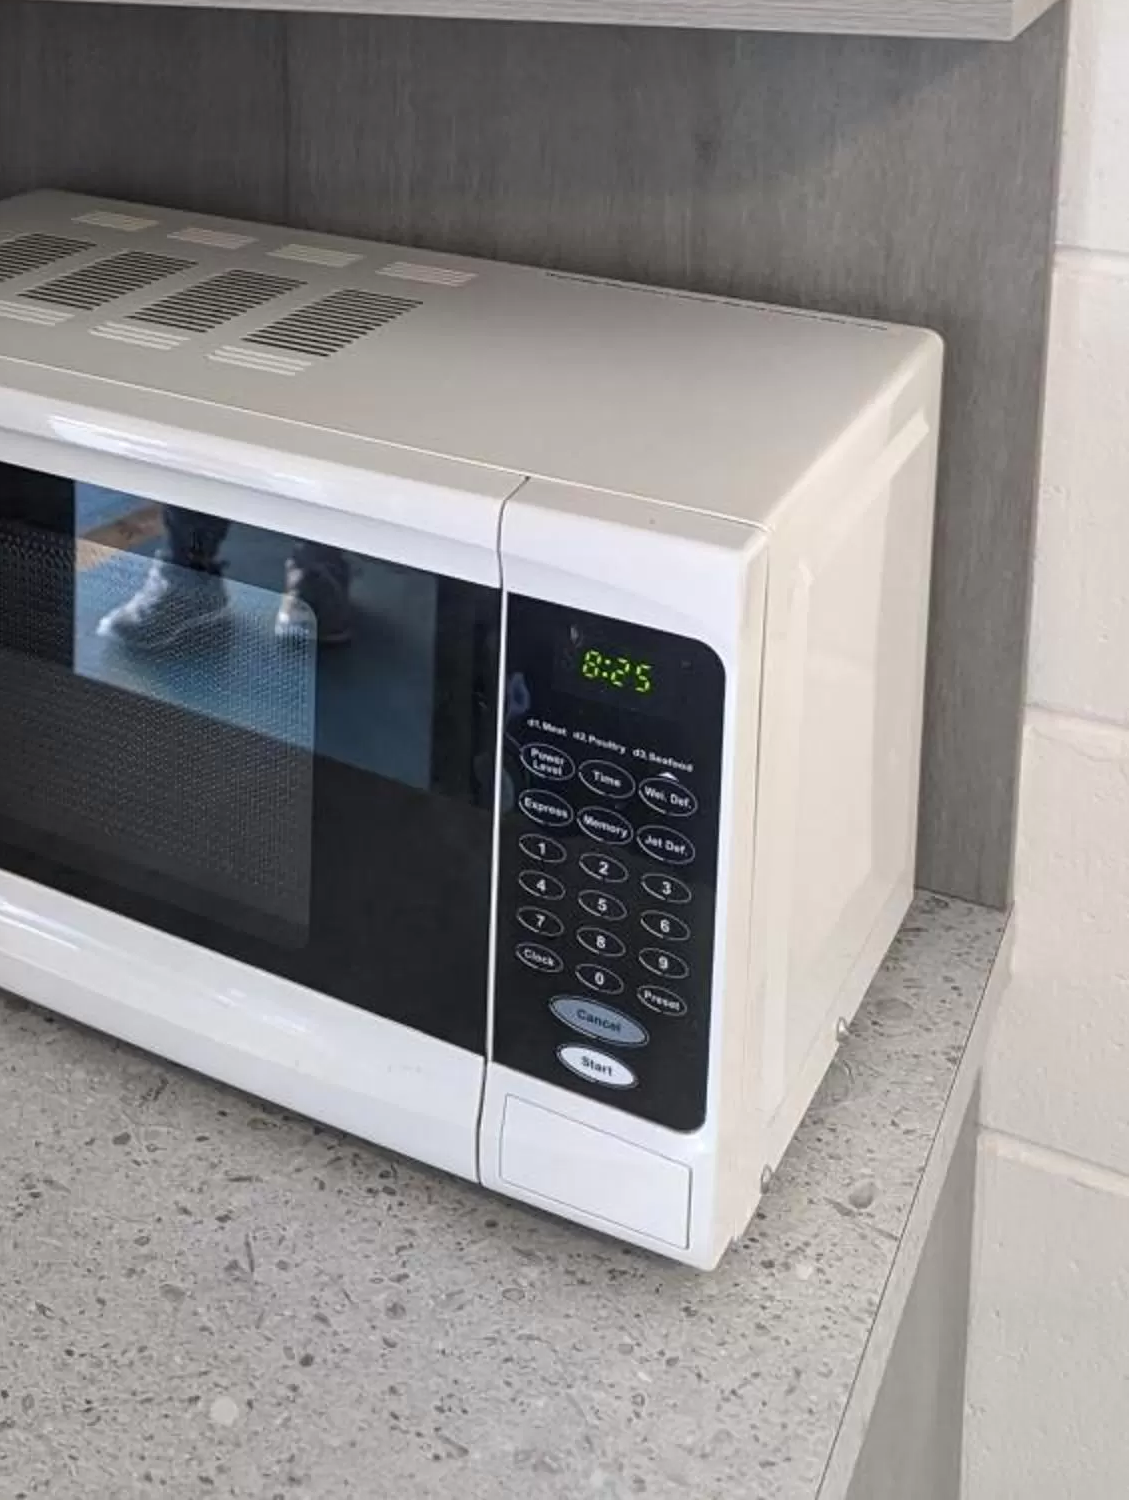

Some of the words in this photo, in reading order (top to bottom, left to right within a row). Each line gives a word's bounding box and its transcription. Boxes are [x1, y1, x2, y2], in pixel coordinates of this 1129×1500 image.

[582, 650, 651, 692] 8:25
[593, 770, 621, 788] Time
[524, 797, 568, 818] Express
[582, 814, 628, 839] Memory
[538, 842, 546, 855] 1
[599, 861, 609, 875] 2
[536, 879, 546, 892] 4
[662, 881, 672, 895] 3
[597, 899, 607, 912] 5
[536, 914, 546, 928] 7
[660, 919, 670, 933] 6
[596, 935, 606, 949] 8
[524, 949, 555, 967] Clock
[658, 956, 668, 969] 9
[644, 989, 680, 1011] Preset
[576, 1008, 621, 1032] Cancel
[581, 1055, 613, 1076] Start
